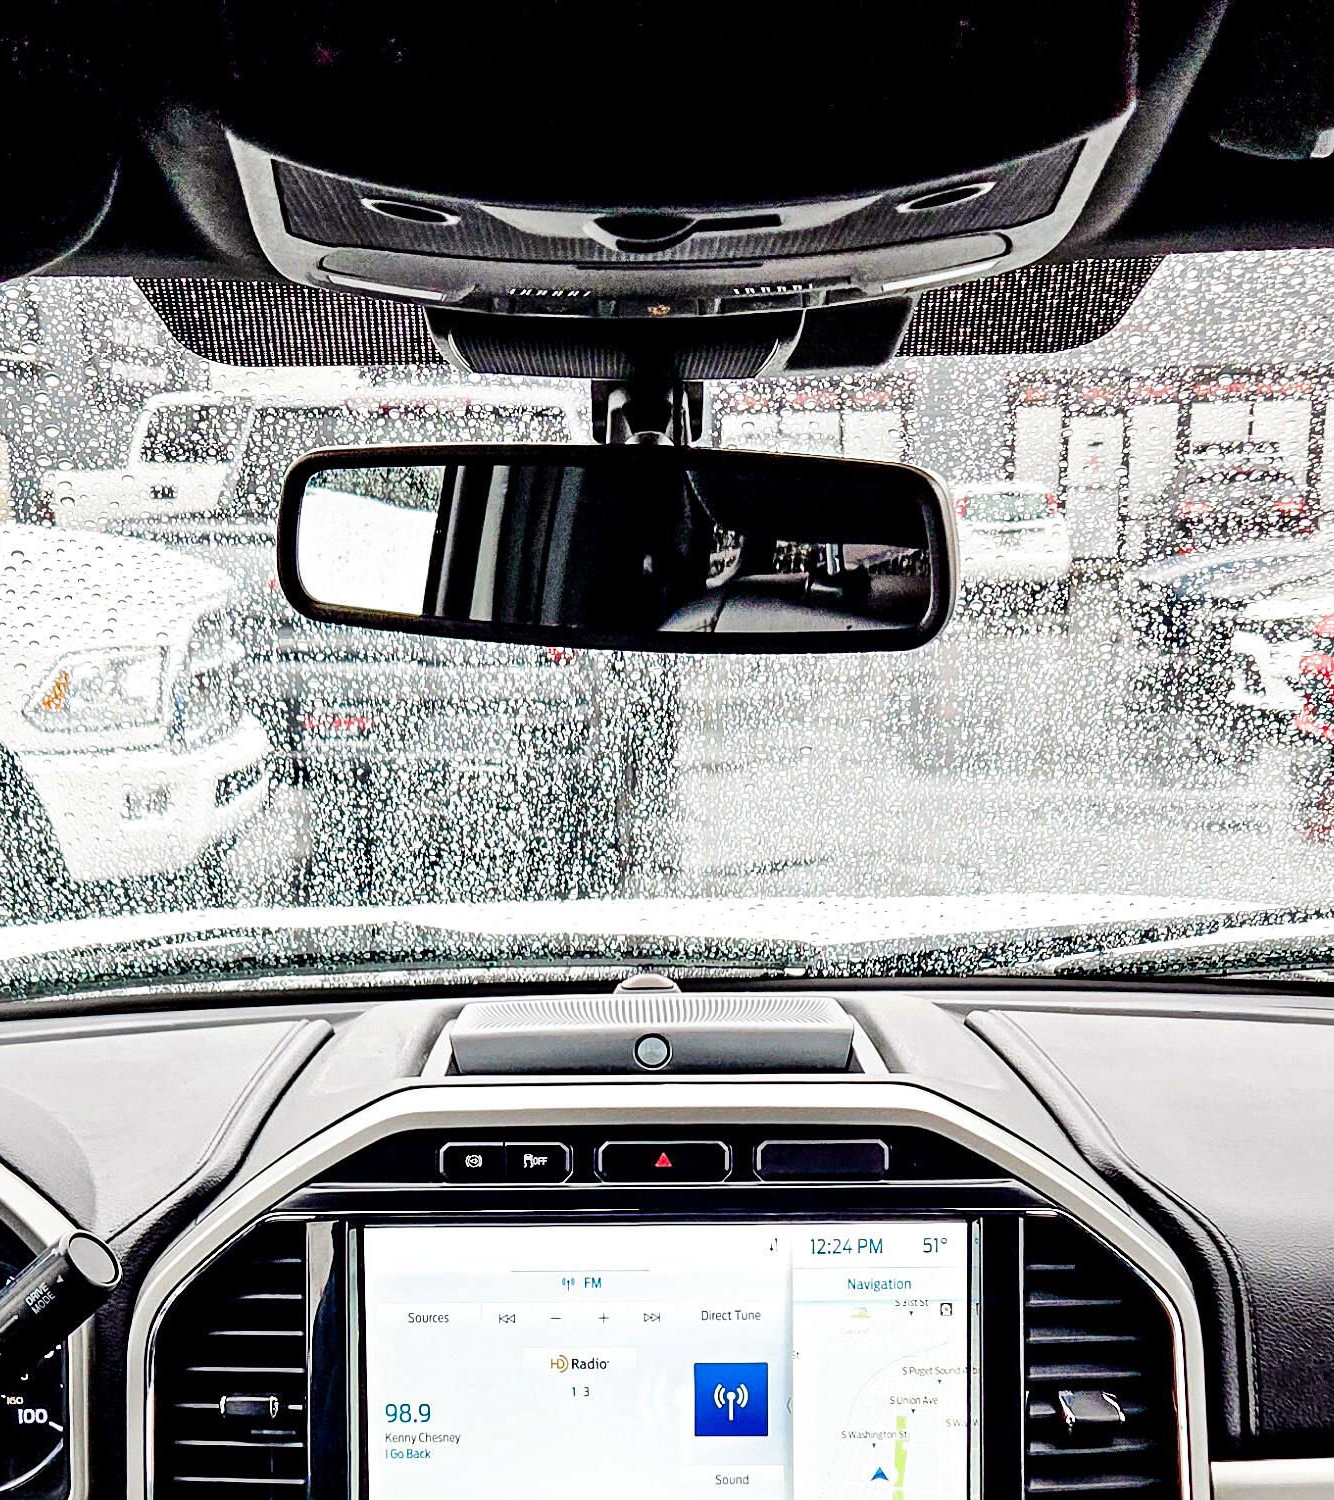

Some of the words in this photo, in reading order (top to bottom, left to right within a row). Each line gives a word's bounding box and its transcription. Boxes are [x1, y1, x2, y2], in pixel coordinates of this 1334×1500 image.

[533, 1156, 548, 1166] OFF
[810, 1238, 853, 1255] 12:24
[857, 1238, 884, 1254] PM
[923, 1237, 948, 1253] 51°
[584, 1277, 602, 1288] FM
[847, 1278, 912, 1291] Navigation
[25, 1282, 50, 1306] DRIVE
[31, 1291, 56, 1315] MODE
[407, 1312, 450, 1323] Sources
[701, 1310, 731, 1321] Direct
[735, 1310, 762, 1321] Tune
[571, 1358, 608, 1369] Radio
[18, 1408, 48, 1424] 100
[385, 1403, 431, 1423] 98.9
[385, 1432, 417, 1444] Kenny
[418, 1432, 461, 1444] Chesney
[390, 1449, 405, 1459] Go
[406, 1449, 431, 1459] Back
[715, 1474, 750, 1486] Sound
